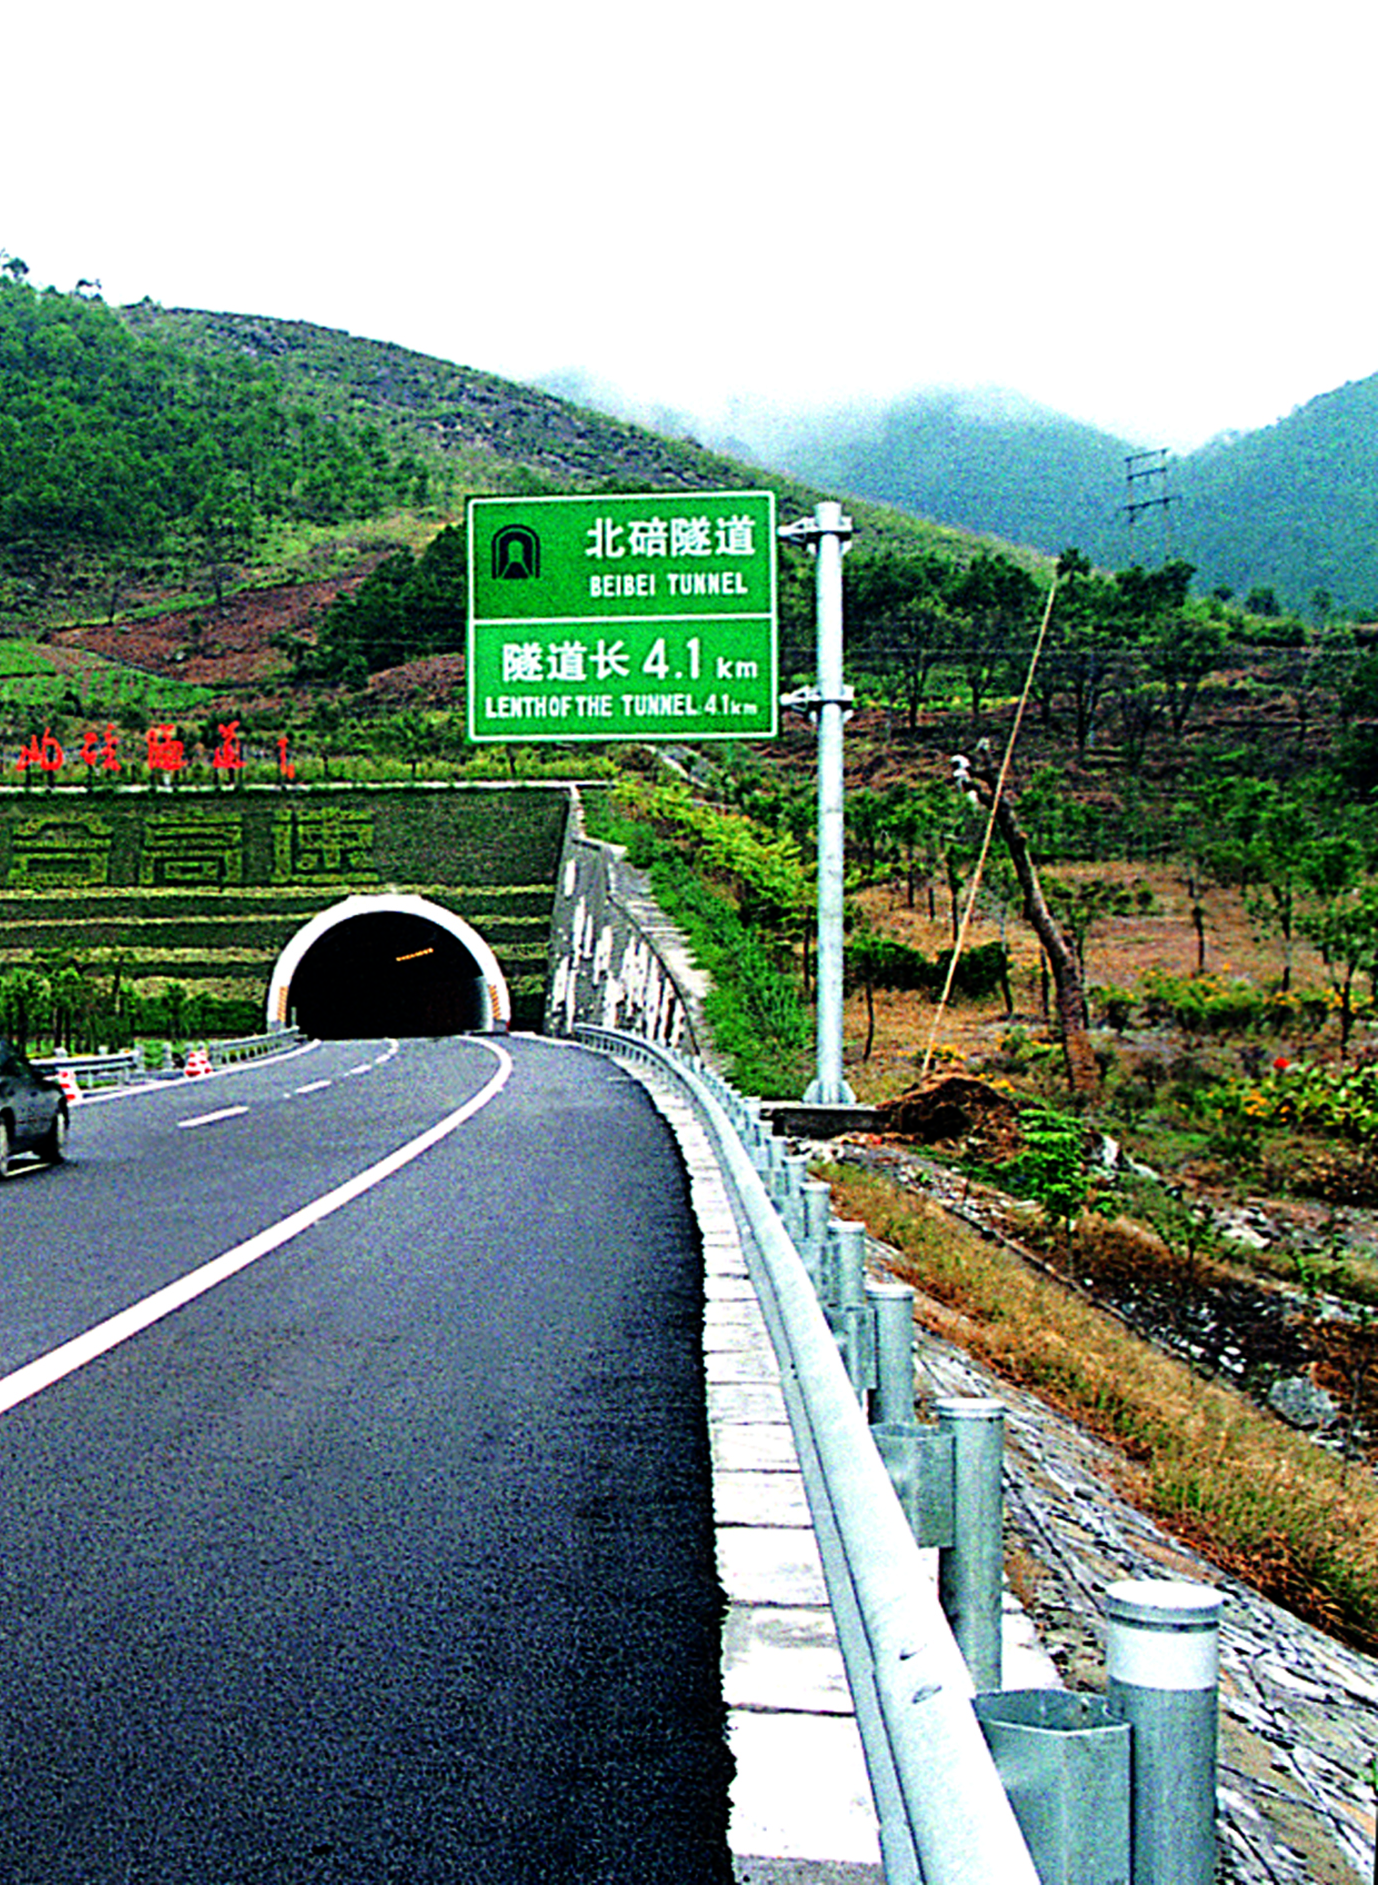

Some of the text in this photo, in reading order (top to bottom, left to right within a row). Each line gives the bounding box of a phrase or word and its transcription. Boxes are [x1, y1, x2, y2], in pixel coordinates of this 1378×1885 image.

[585, 514, 756, 558] 北碚隧道
[590, 571, 748, 597] BEIBEI TUNNEL
[503, 637, 758, 682] 隧道长 4.1 km
